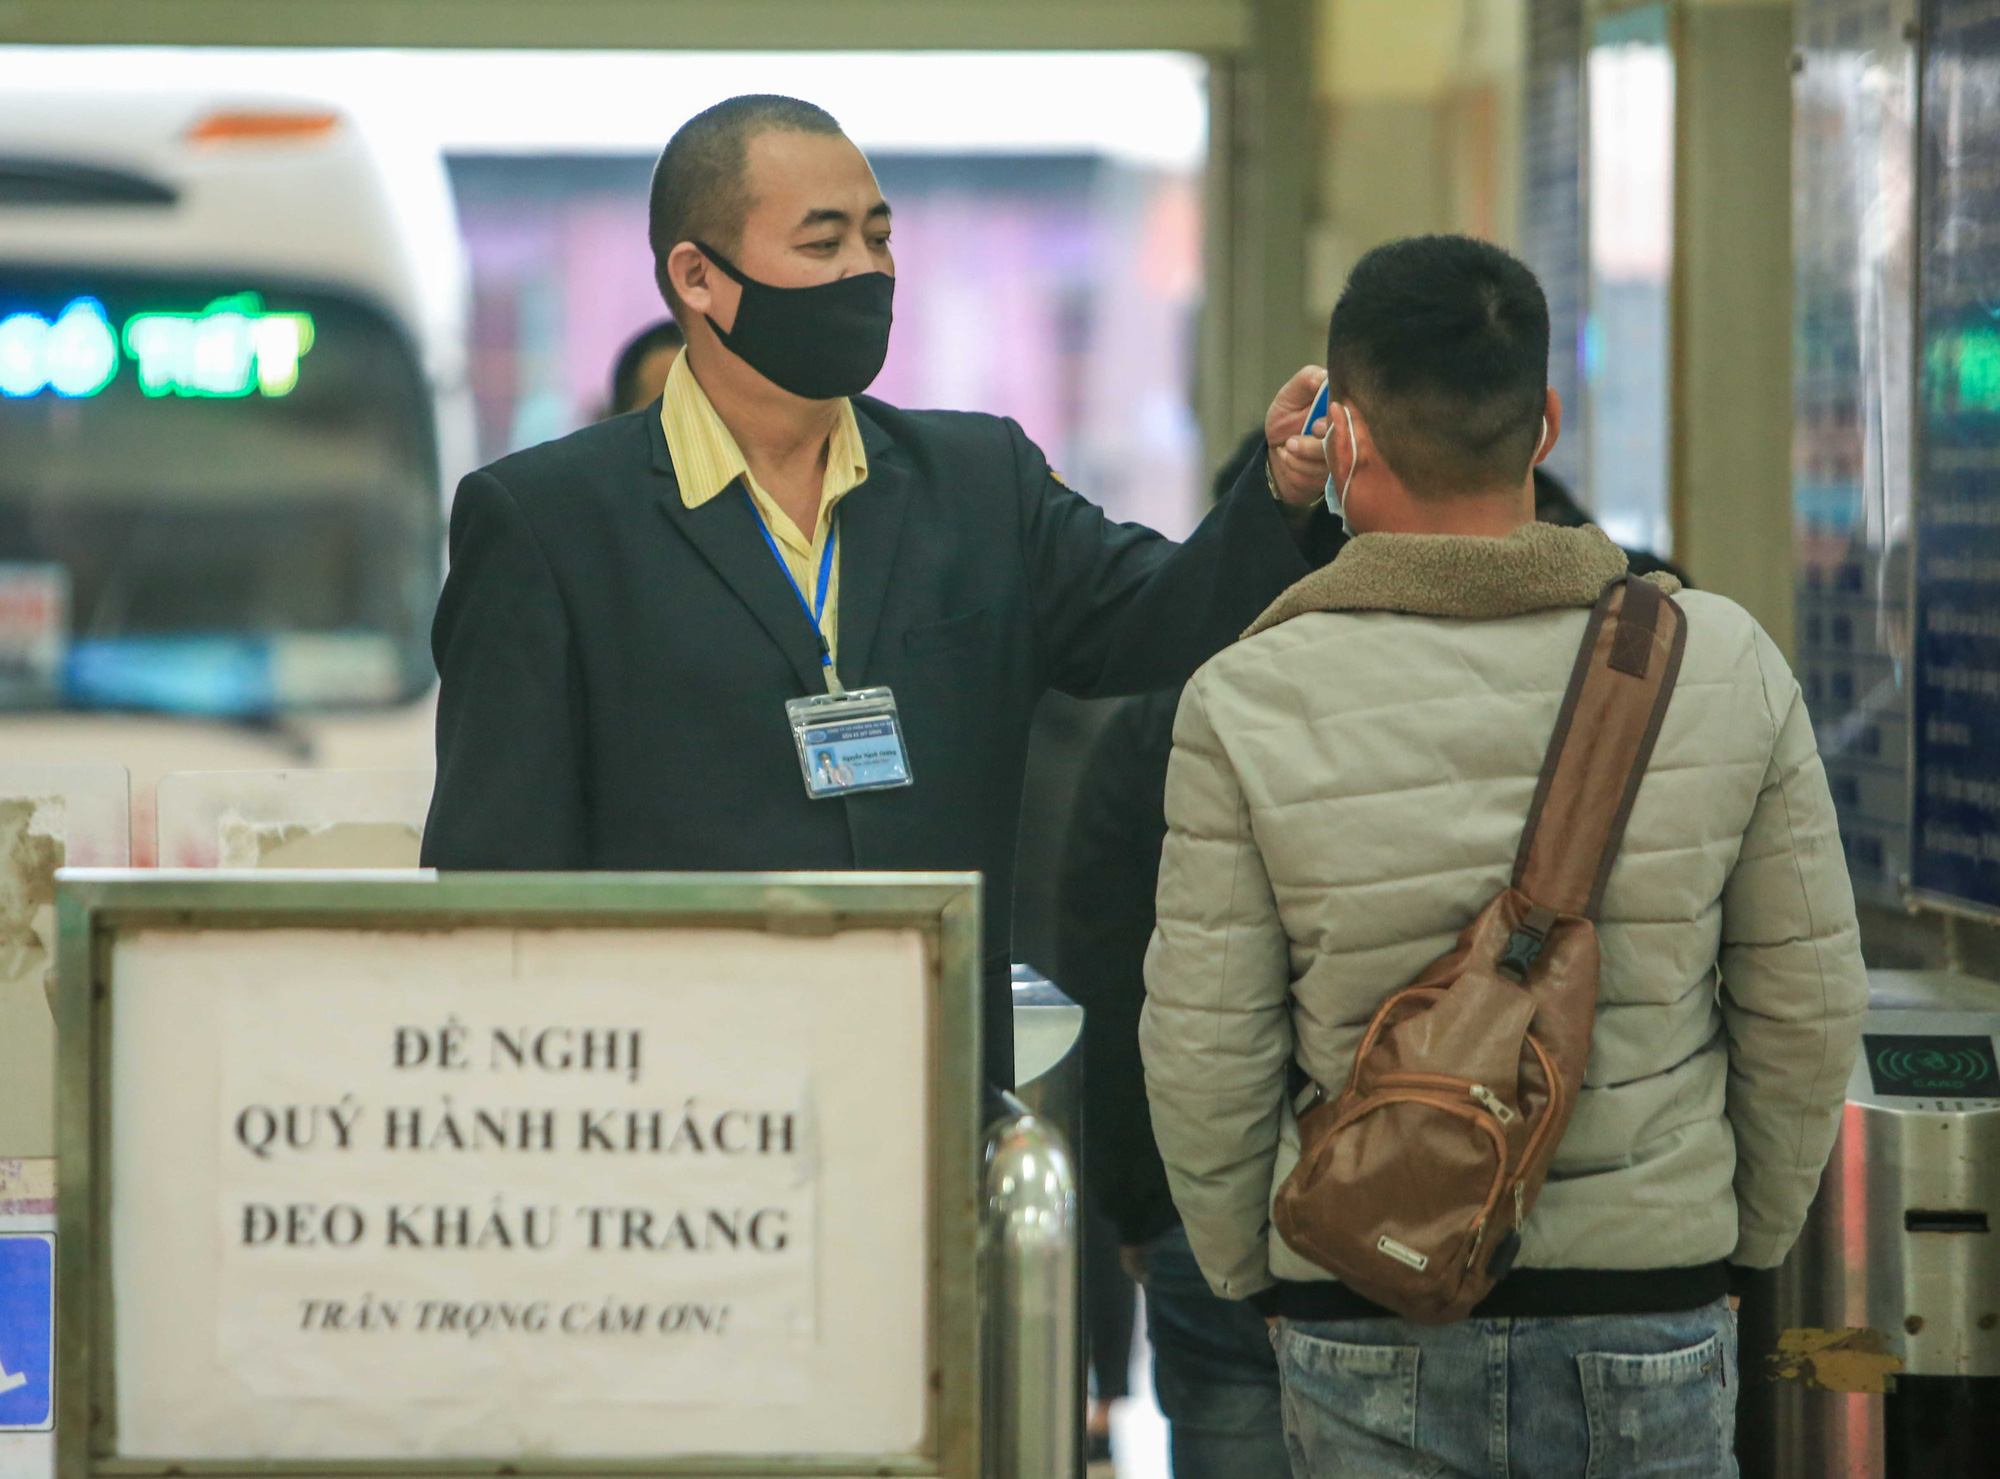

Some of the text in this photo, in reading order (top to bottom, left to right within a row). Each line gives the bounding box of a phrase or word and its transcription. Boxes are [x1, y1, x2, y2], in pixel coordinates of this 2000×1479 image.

[491, 1027, 644, 1083] NGHỊ
[234, 1094, 798, 1160] QUÝ HÀNH KHÁCH
[240, 1190, 789, 1252] ĐEO KHẨU TRANG
[298, 1291, 403, 1333] TRÂN
[415, 1300, 550, 1339] TRỌNG
